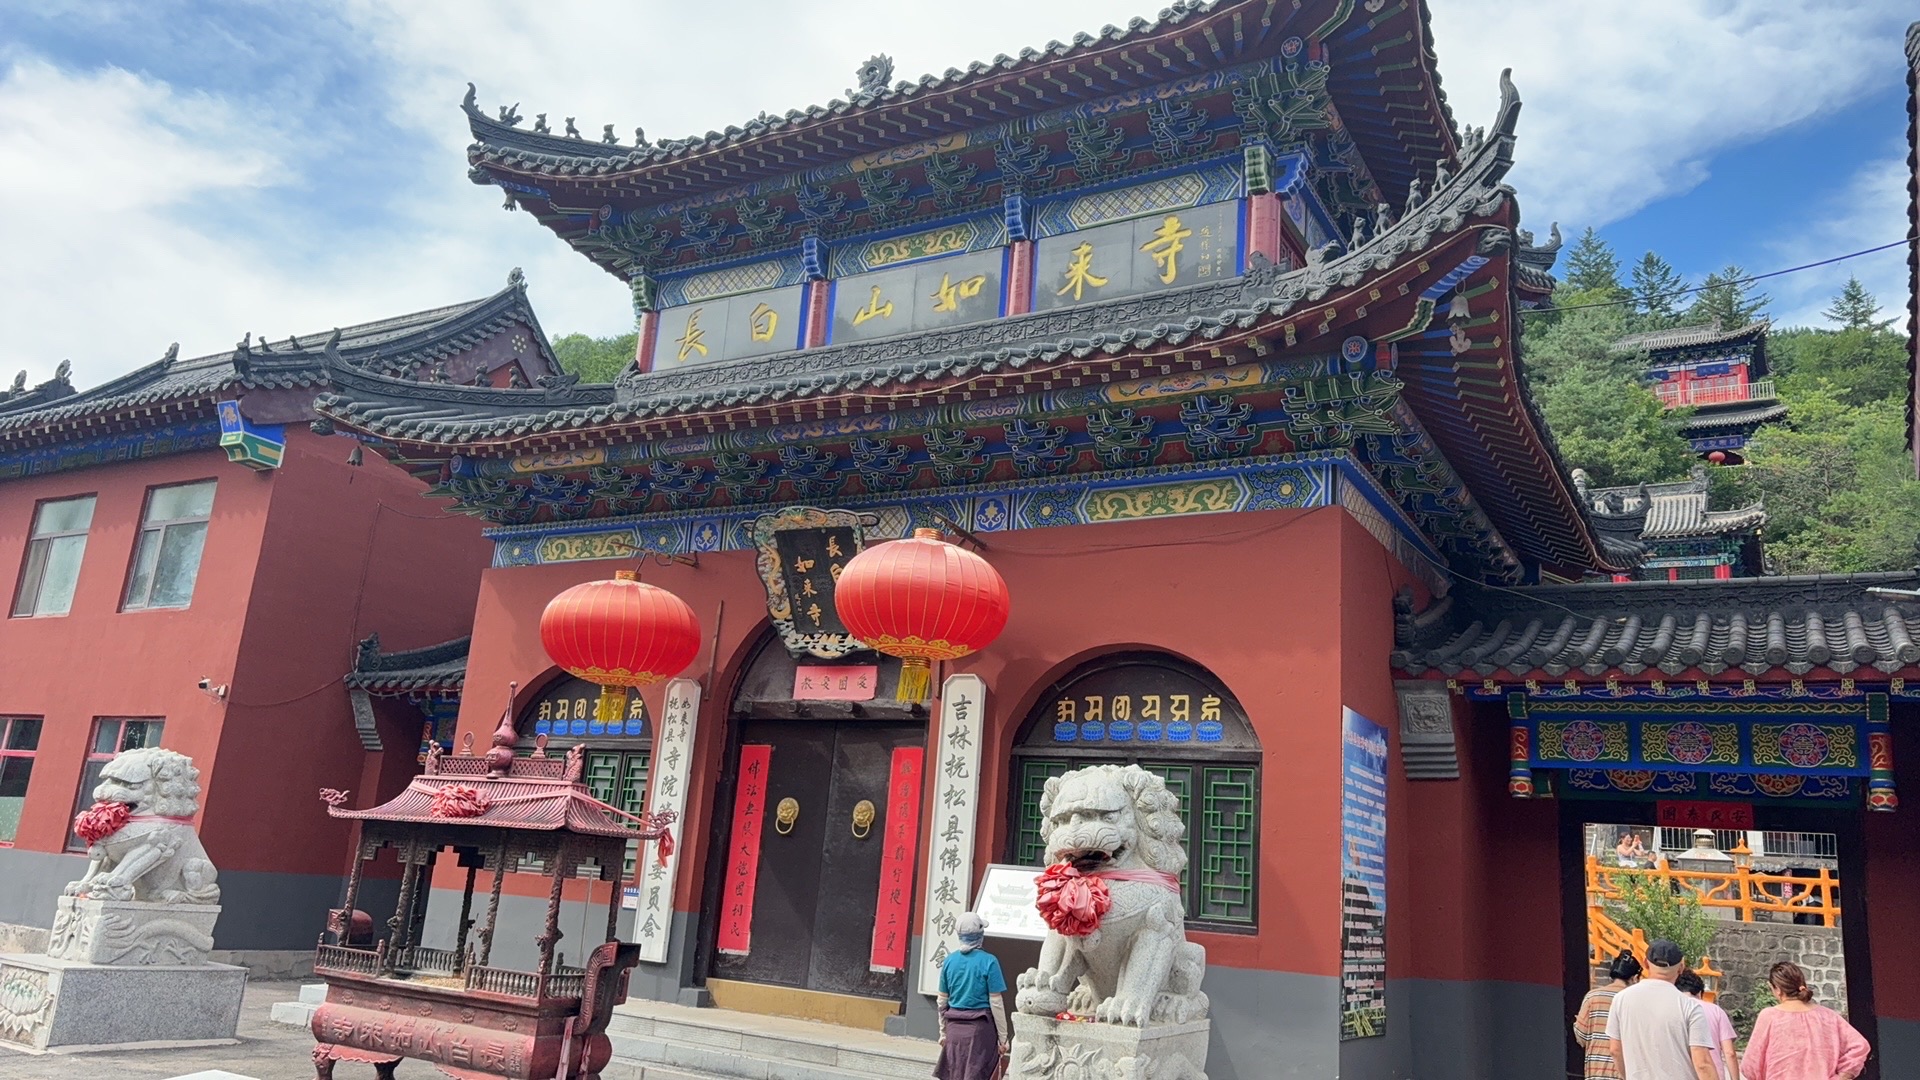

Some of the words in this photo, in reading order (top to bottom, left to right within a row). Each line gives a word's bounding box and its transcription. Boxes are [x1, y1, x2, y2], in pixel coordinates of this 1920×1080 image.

[640, 746, 681, 939] 寺院委员会
